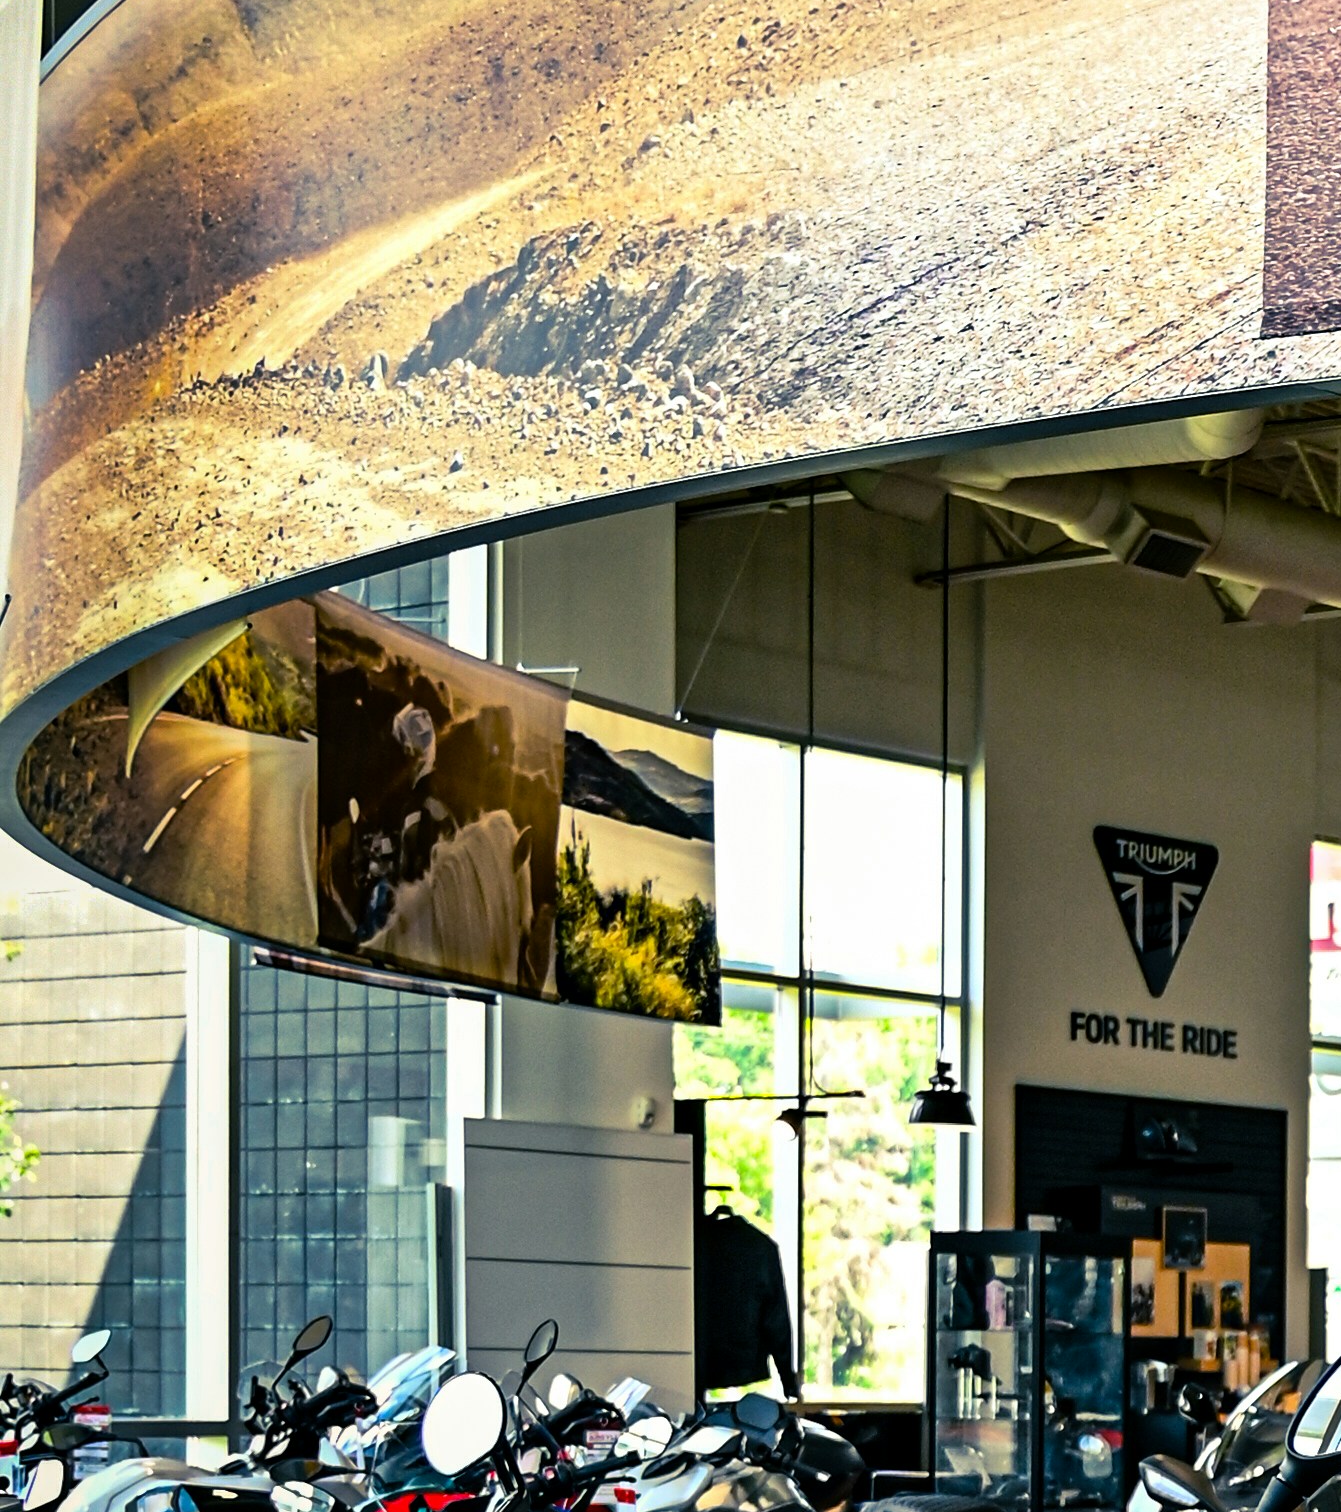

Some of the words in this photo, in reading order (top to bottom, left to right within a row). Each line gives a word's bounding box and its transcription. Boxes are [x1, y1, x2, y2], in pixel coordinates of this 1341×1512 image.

[1116, 839, 1196, 870] TRIUMPH
[1070, 1011, 1120, 1045] FOR
[1126, 1017, 1175, 1052] THE
[1182, 1025, 1238, 1059] RIDE
